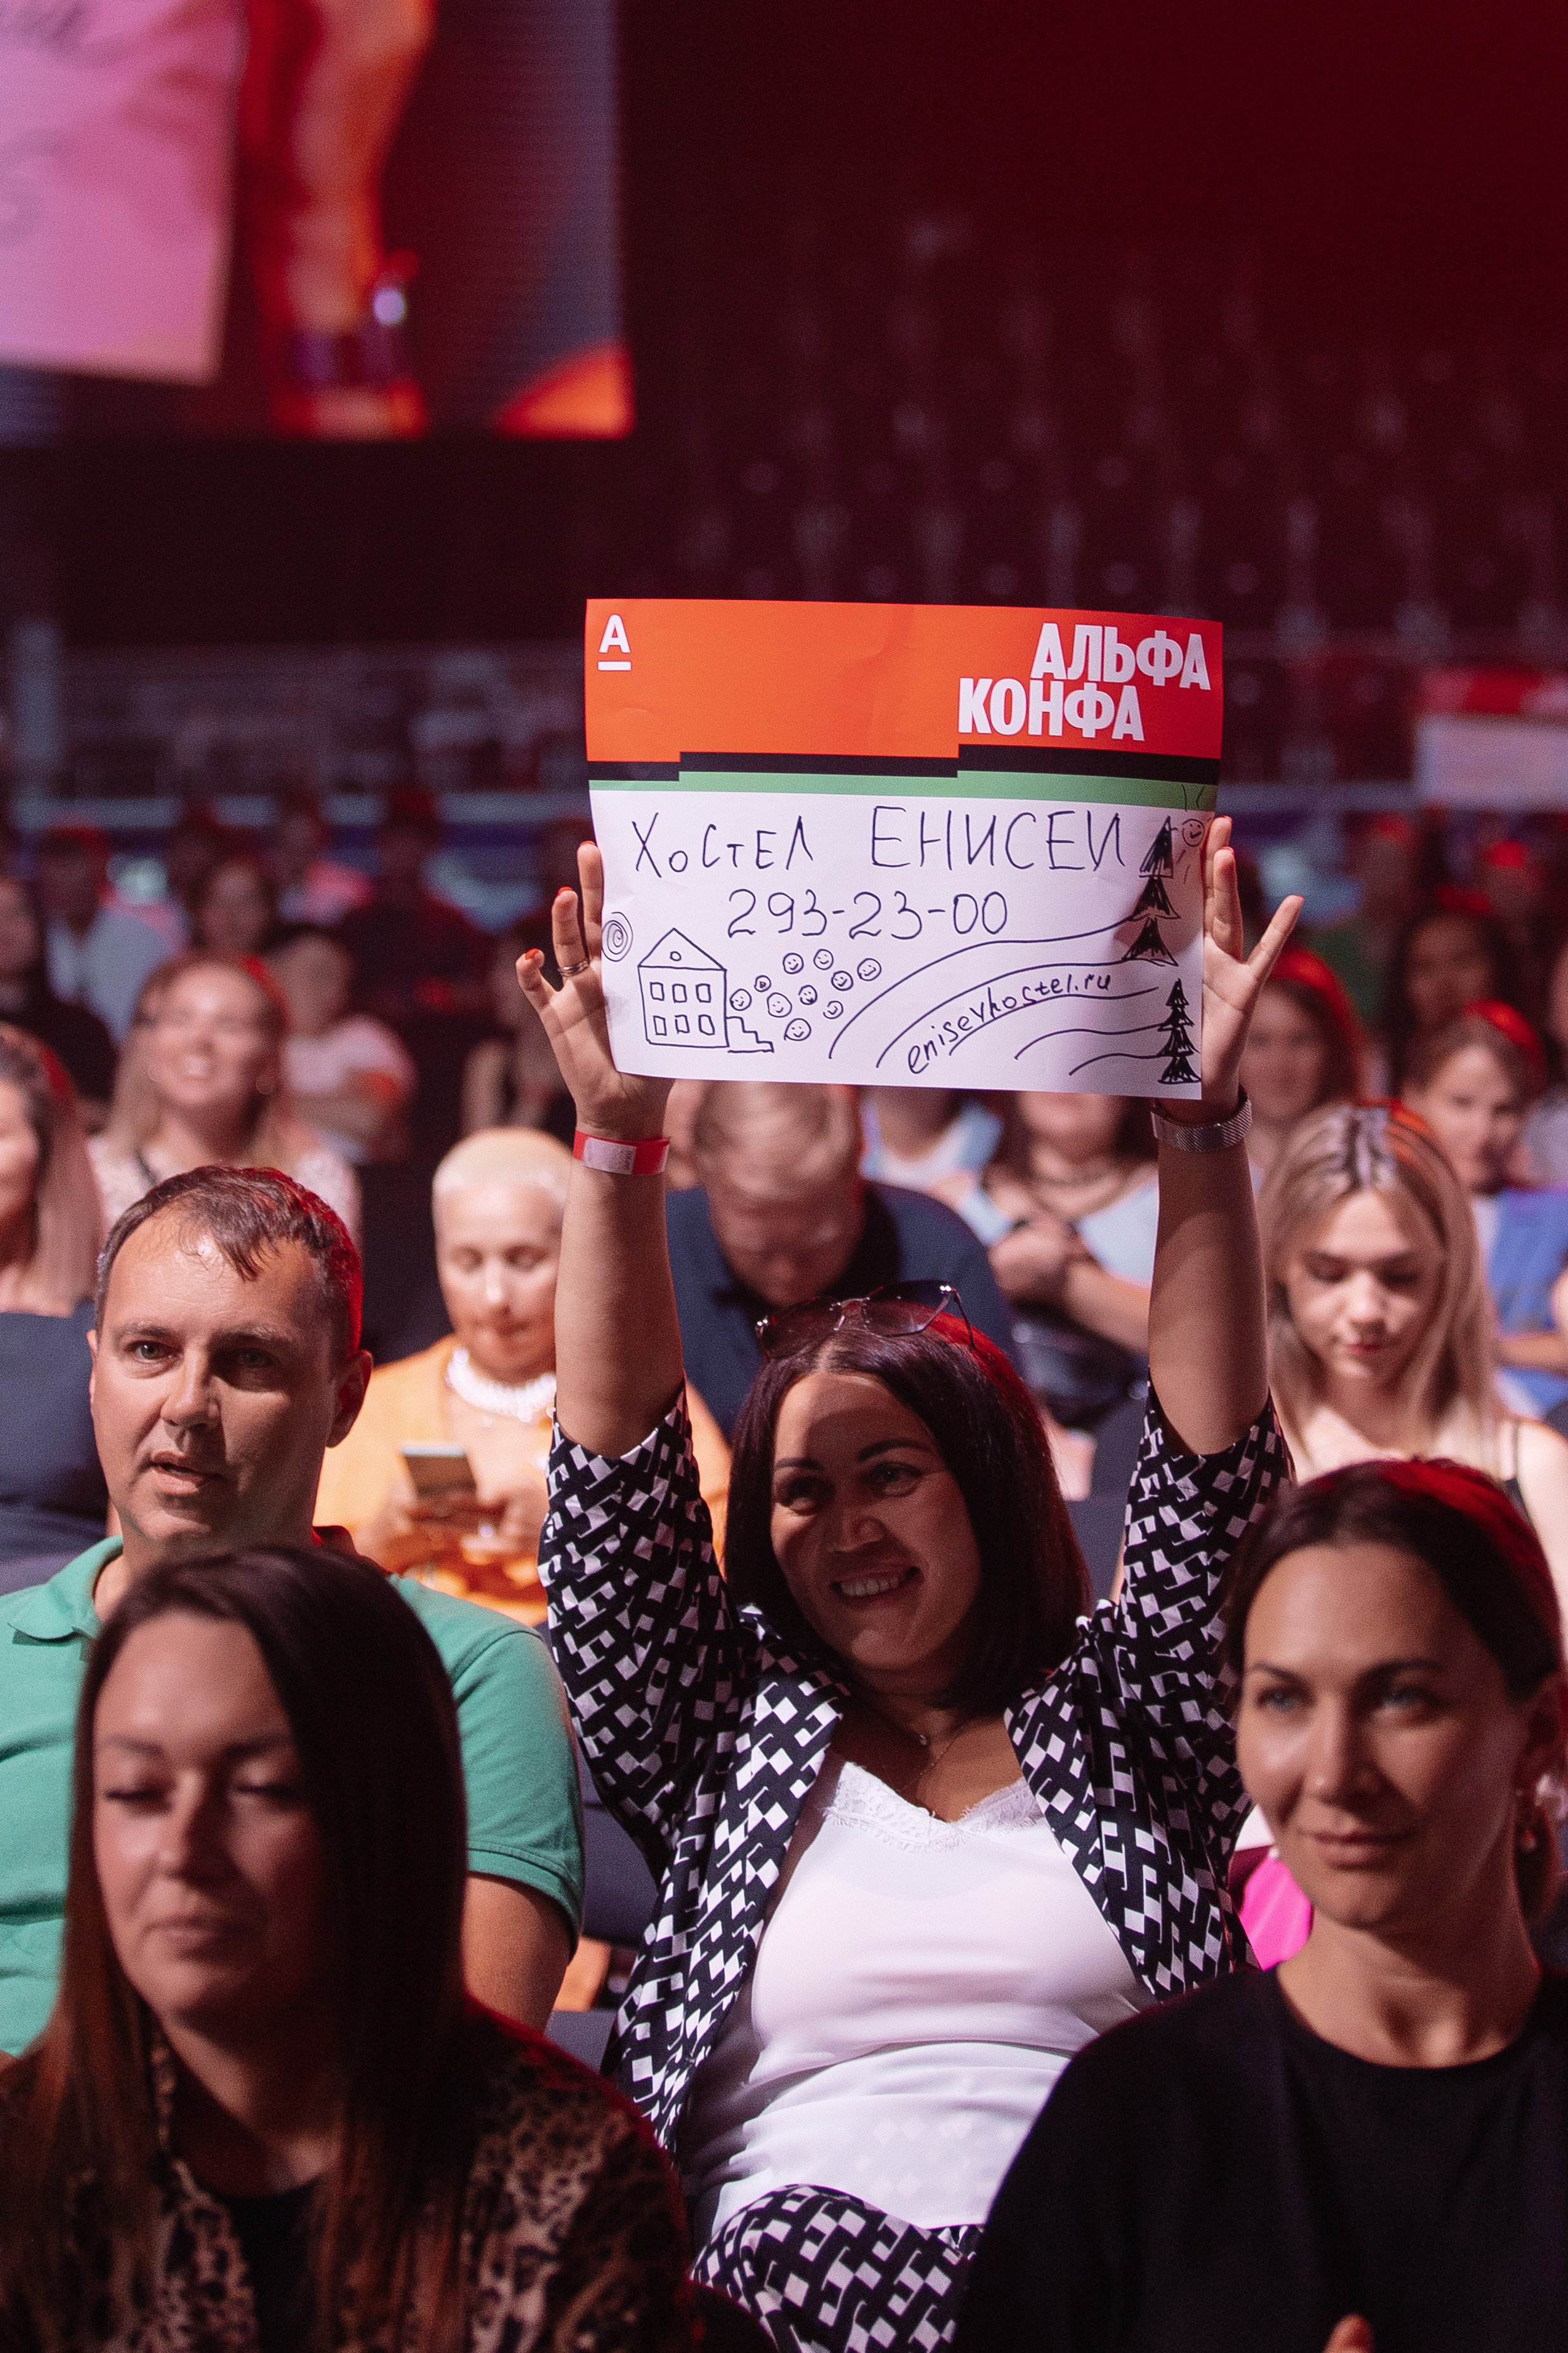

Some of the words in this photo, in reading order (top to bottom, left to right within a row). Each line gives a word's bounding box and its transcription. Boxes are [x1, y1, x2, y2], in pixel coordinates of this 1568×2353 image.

[1030, 622, 1212, 691] АЛЬФА
[958, 677, 1145, 742] КОНФА
[727, 888, 1008, 941] 293-23-00
